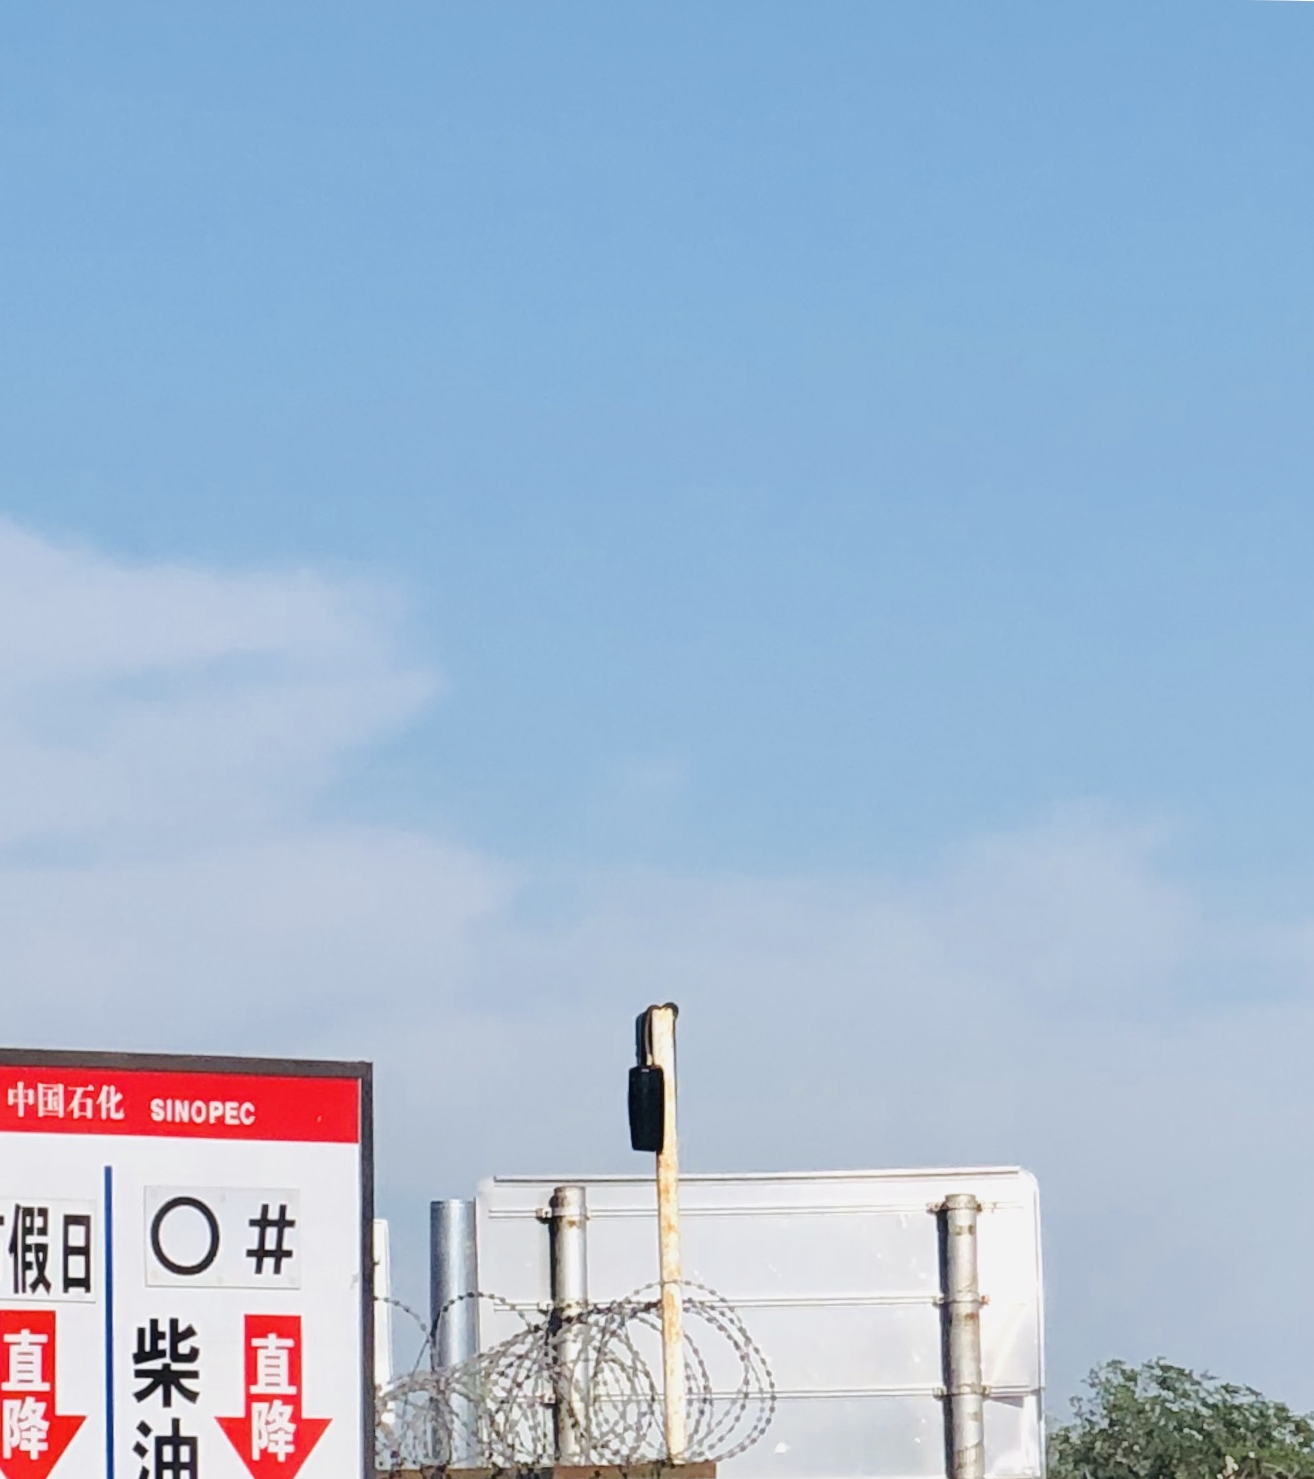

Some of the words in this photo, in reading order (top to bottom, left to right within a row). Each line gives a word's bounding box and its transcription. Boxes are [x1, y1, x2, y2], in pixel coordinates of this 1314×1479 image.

[6, 1081, 125, 1121] 中国石化
[150, 1098, 256, 1126] SINOPEC
[1, 1329, 51, 1461] 直降
[249, 1333, 298, 1463] 直降
